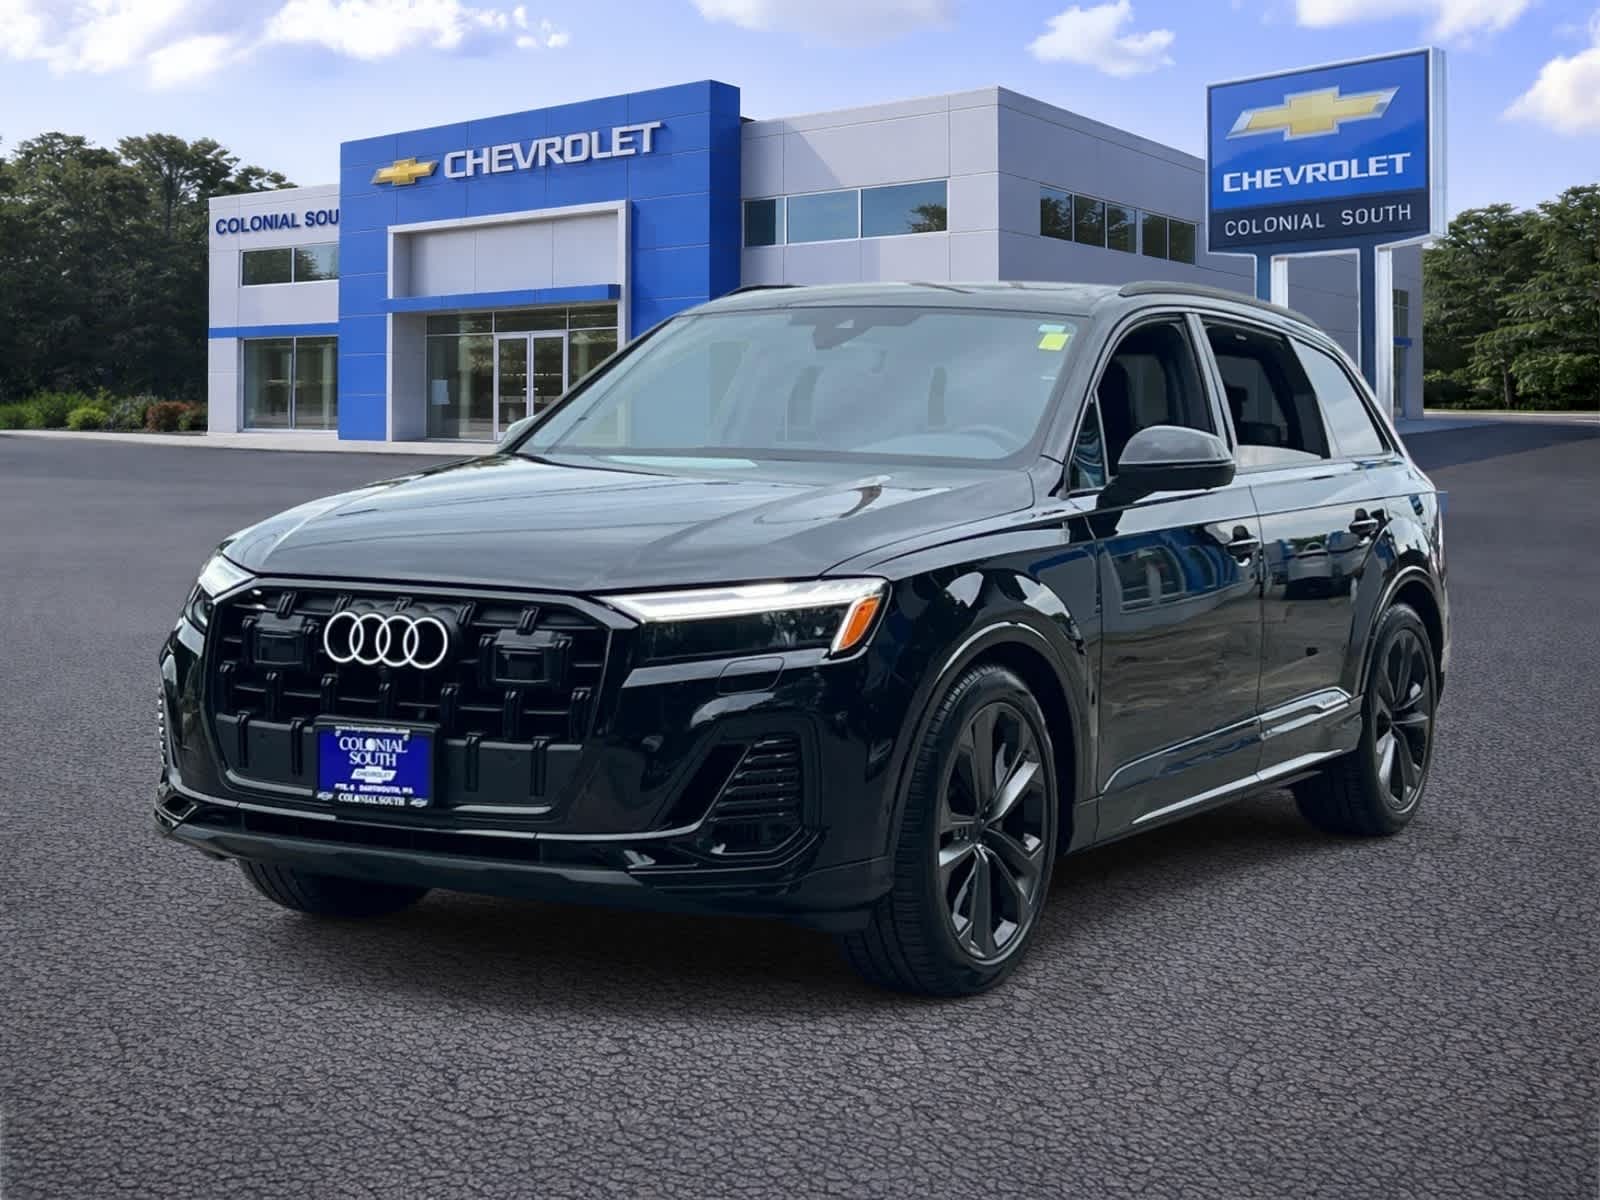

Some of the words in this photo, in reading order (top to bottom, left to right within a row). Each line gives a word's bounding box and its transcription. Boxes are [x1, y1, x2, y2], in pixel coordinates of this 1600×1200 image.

[444, 120, 662, 179] CHEVROLET
[1223, 152, 1411, 192] CHEVROLET
[215, 213, 301, 235] COLONIAL
[304, 209, 340, 227] SOU
[1224, 213, 1326, 236] COLONIAL
[1341, 204, 1412, 226] SOUTH
[339, 736, 409, 753] COLONIAL
[349, 751, 397, 767] SOUTH
[338, 793, 378, 805] COLONIAL
[379, 796, 405, 807] SOUTH
